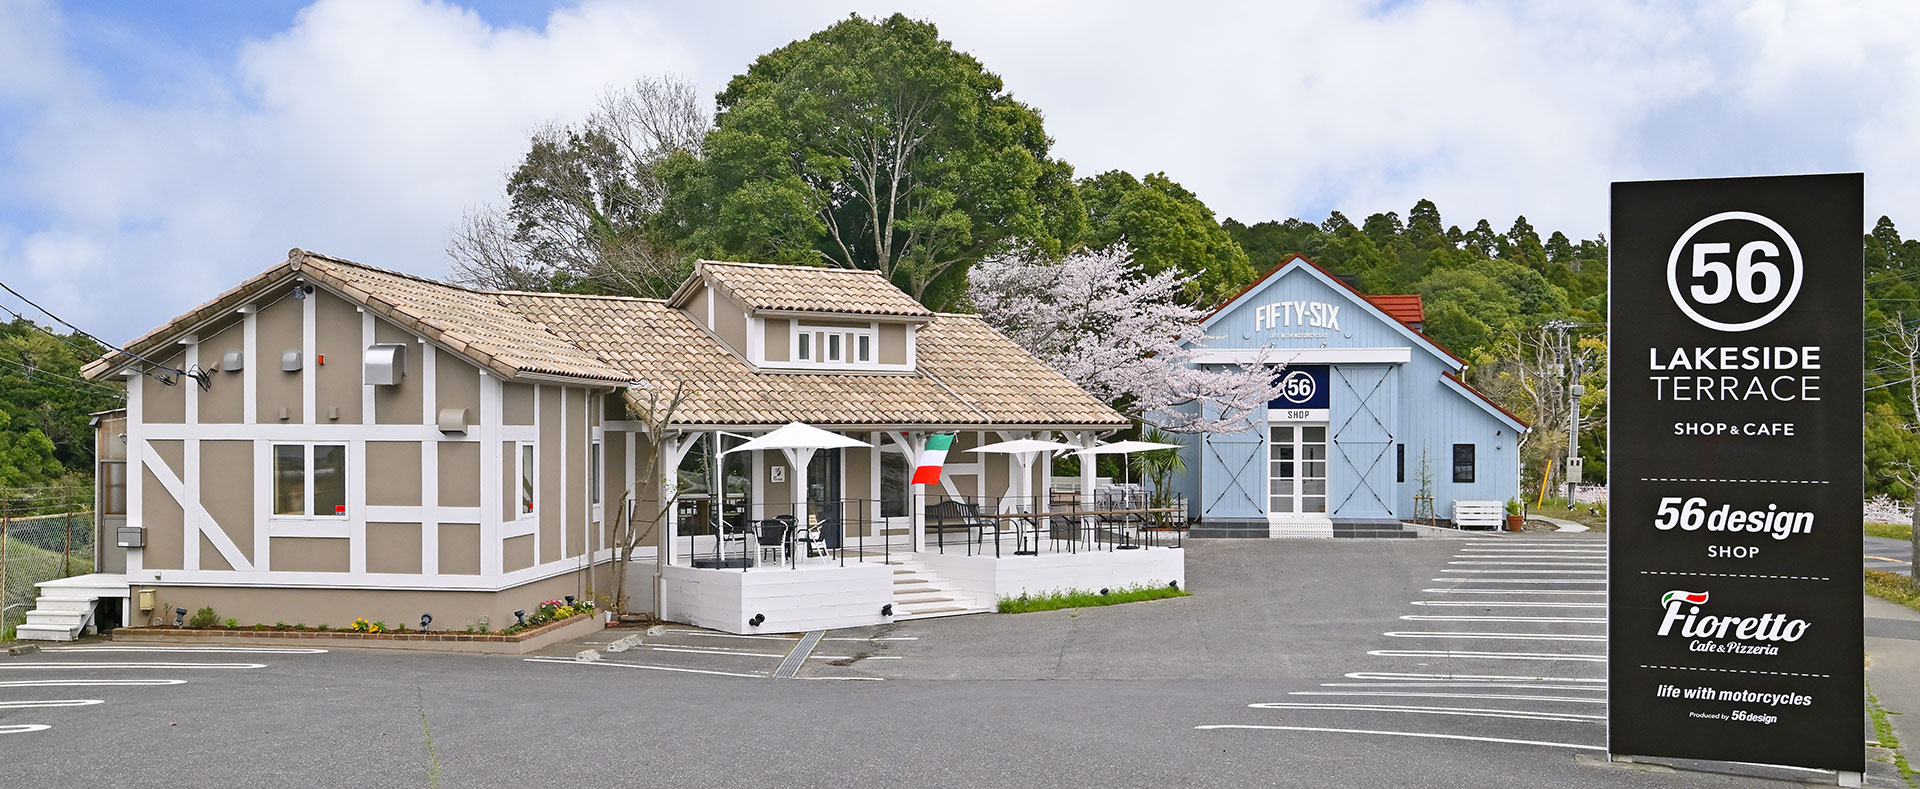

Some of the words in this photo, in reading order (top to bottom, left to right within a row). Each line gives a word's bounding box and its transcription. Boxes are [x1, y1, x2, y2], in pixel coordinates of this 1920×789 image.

[1690, 241, 1782, 305] 56
[1255, 301, 1340, 333] FIFTY-SIX
[1650, 346, 1821, 371] LAKESIDE
[1287, 378, 1311, 397] 56
[1650, 375, 1821, 402] TERRACE
[1287, 410, 1310, 419] SHOP
[1707, 544, 1760, 559] SHOP
[1656, 590, 1811, 643] Fioretto
[1656, 684, 1681, 700] life
[1684, 686, 1716, 701] with
[1718, 689, 1813, 707] motorcycles
[1689, 711, 1720, 720] Produced
[1721, 713, 1729, 722] by
